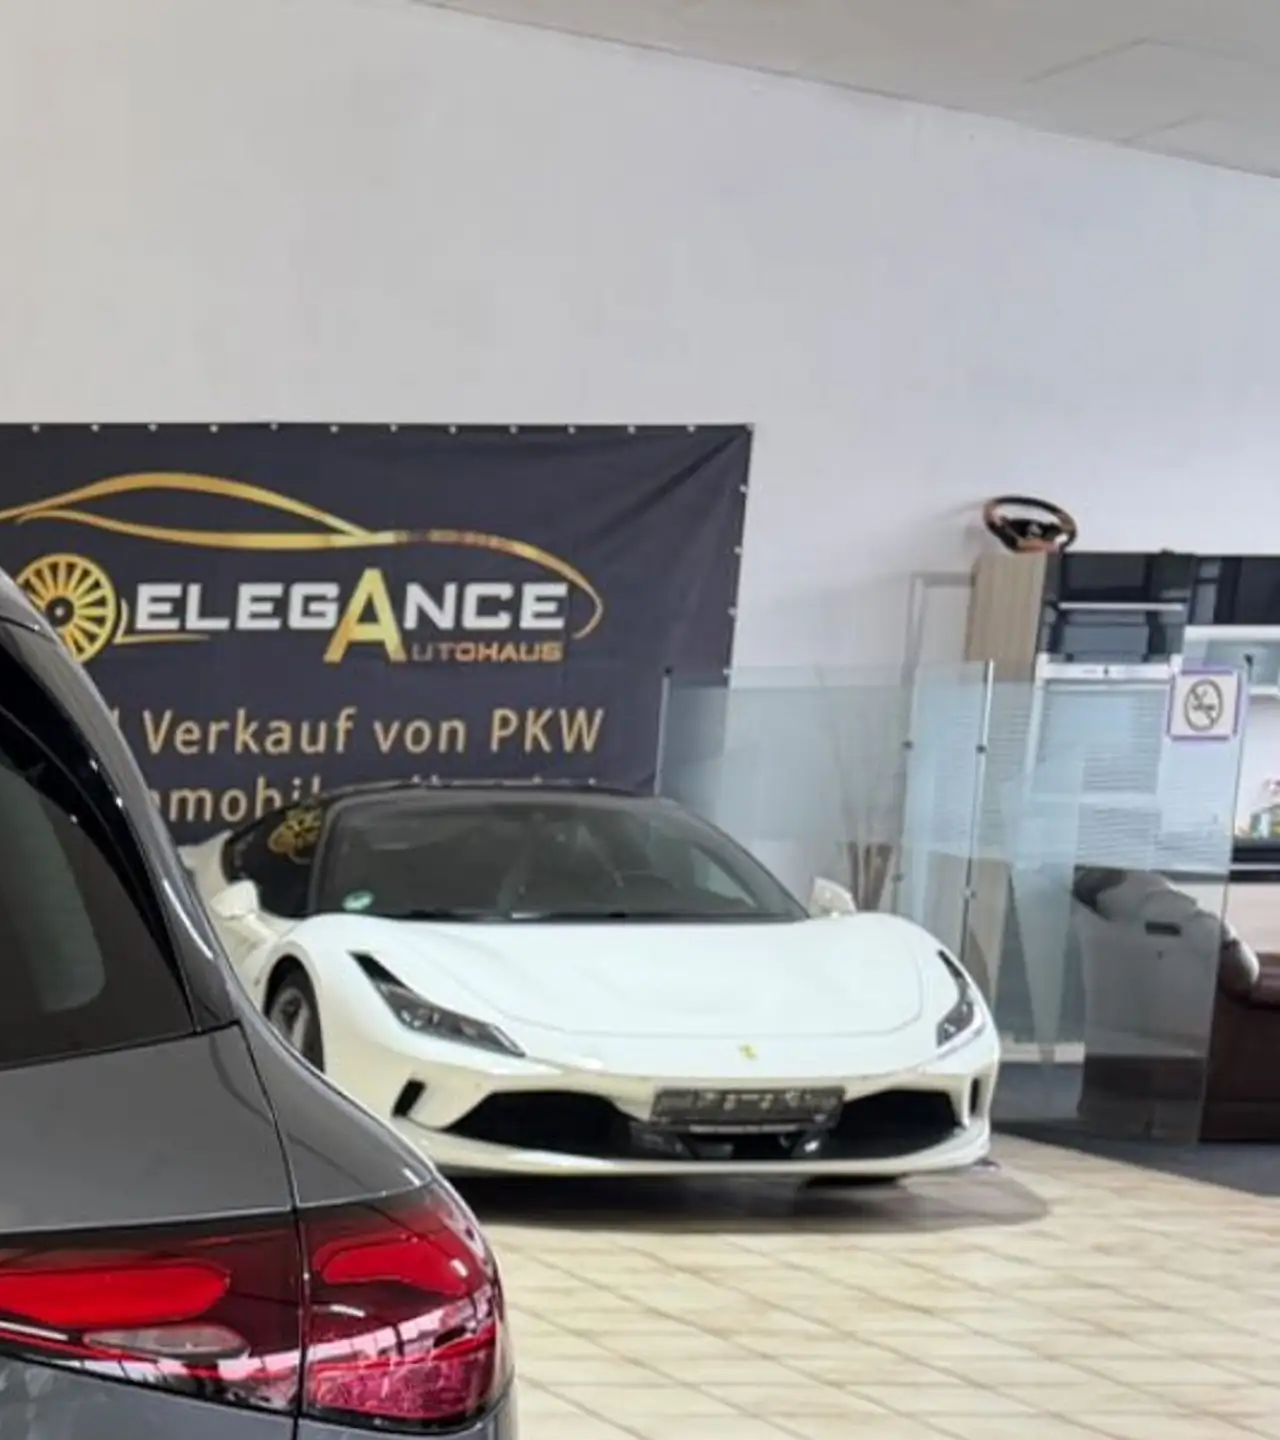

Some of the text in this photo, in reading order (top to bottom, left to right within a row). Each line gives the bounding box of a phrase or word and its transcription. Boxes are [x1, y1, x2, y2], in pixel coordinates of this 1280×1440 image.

[136, 567, 569, 663] ELEGANCE
[142, 705, 357, 755] Verkauf
[373, 719, 466, 755] von
[489, 707, 604, 754] PKW
